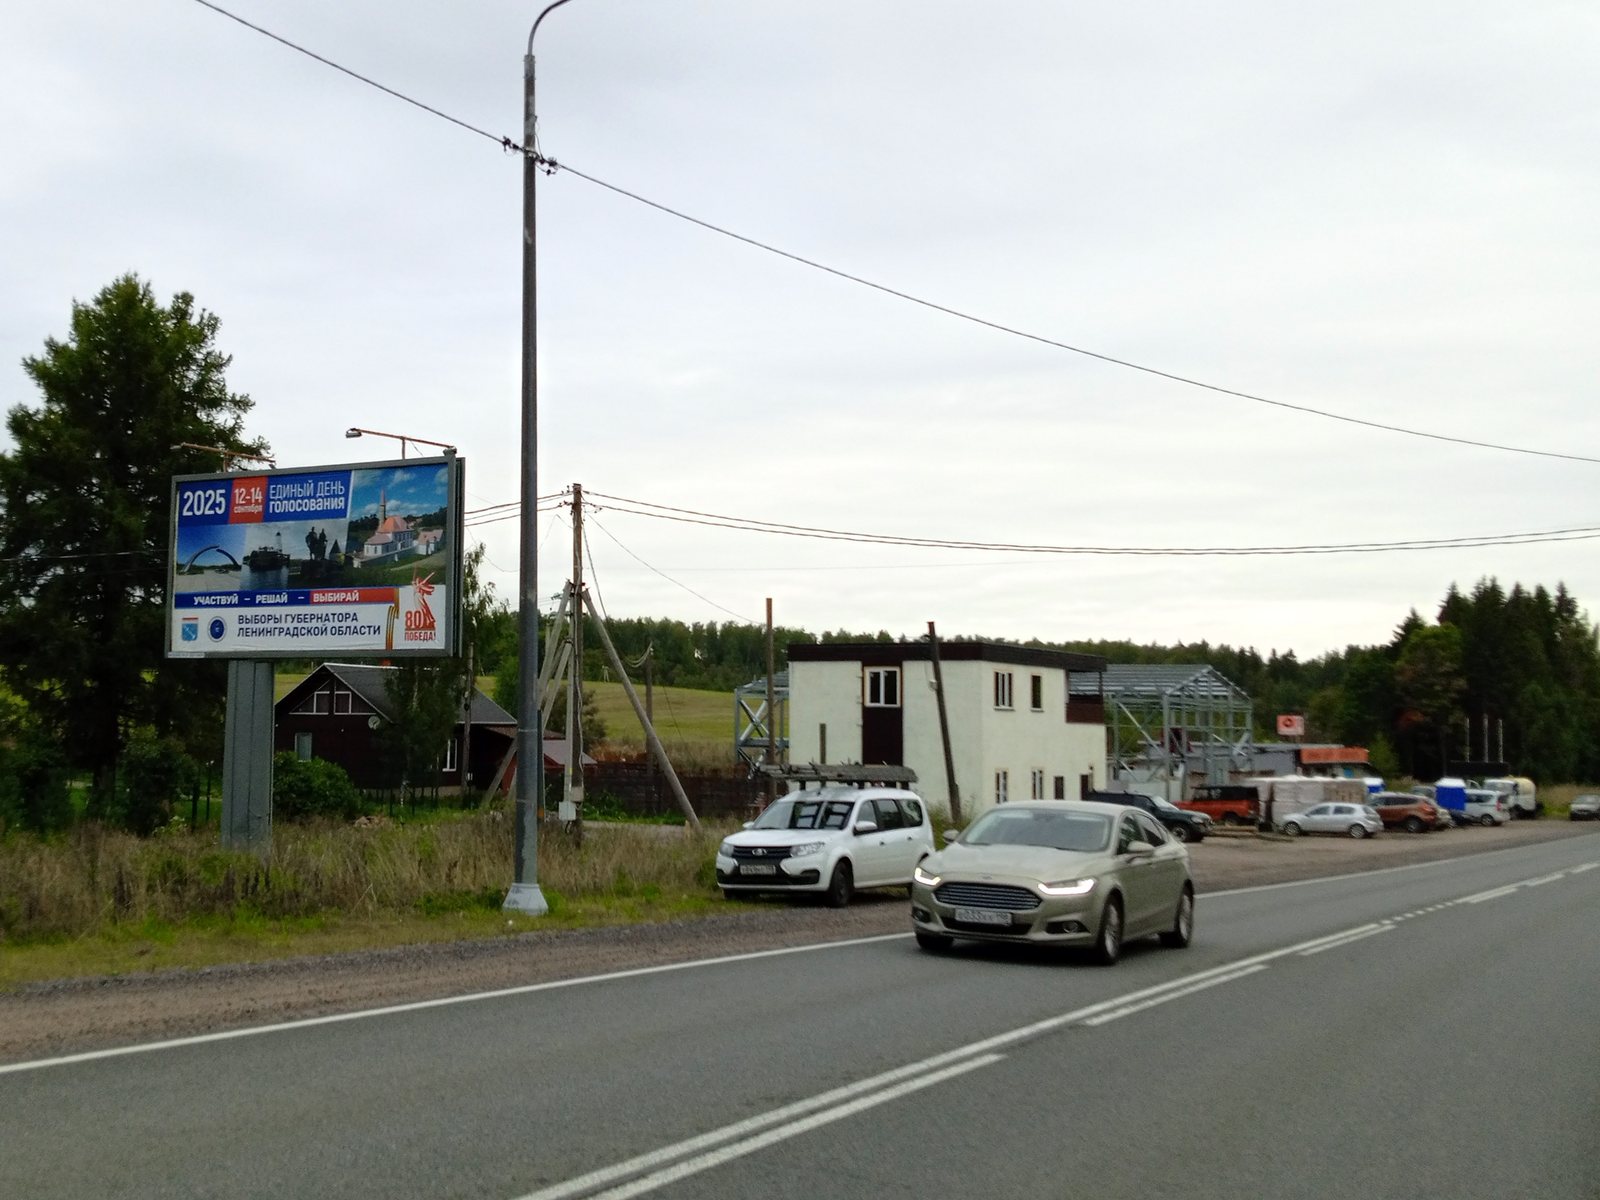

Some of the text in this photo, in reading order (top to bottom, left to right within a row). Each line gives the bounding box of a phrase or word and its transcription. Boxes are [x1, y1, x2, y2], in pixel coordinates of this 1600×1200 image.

[233, 487, 263, 504] 12-14
[269, 480, 345, 500] ЕДИНЫЙ ДЕНЬ
[182, 489, 226, 516] 2025
[269, 497, 345, 514] голосования
[193, 593, 239, 605] УЧАСТВУЙ
[255, 592, 288, 604] РЕШАЙ
[313, 590, 359, 603] ВЫБИРАЙ
[238, 612, 359, 625] ВЫБОРЫ ГУБЕРНАТОРА
[405, 610, 422, 629] 80
[237, 624, 381, 638] ЛЕНИНГРАДСКОЙ ОБЛАСТИ
[404, 631, 436, 642] ПОБЕДА!
